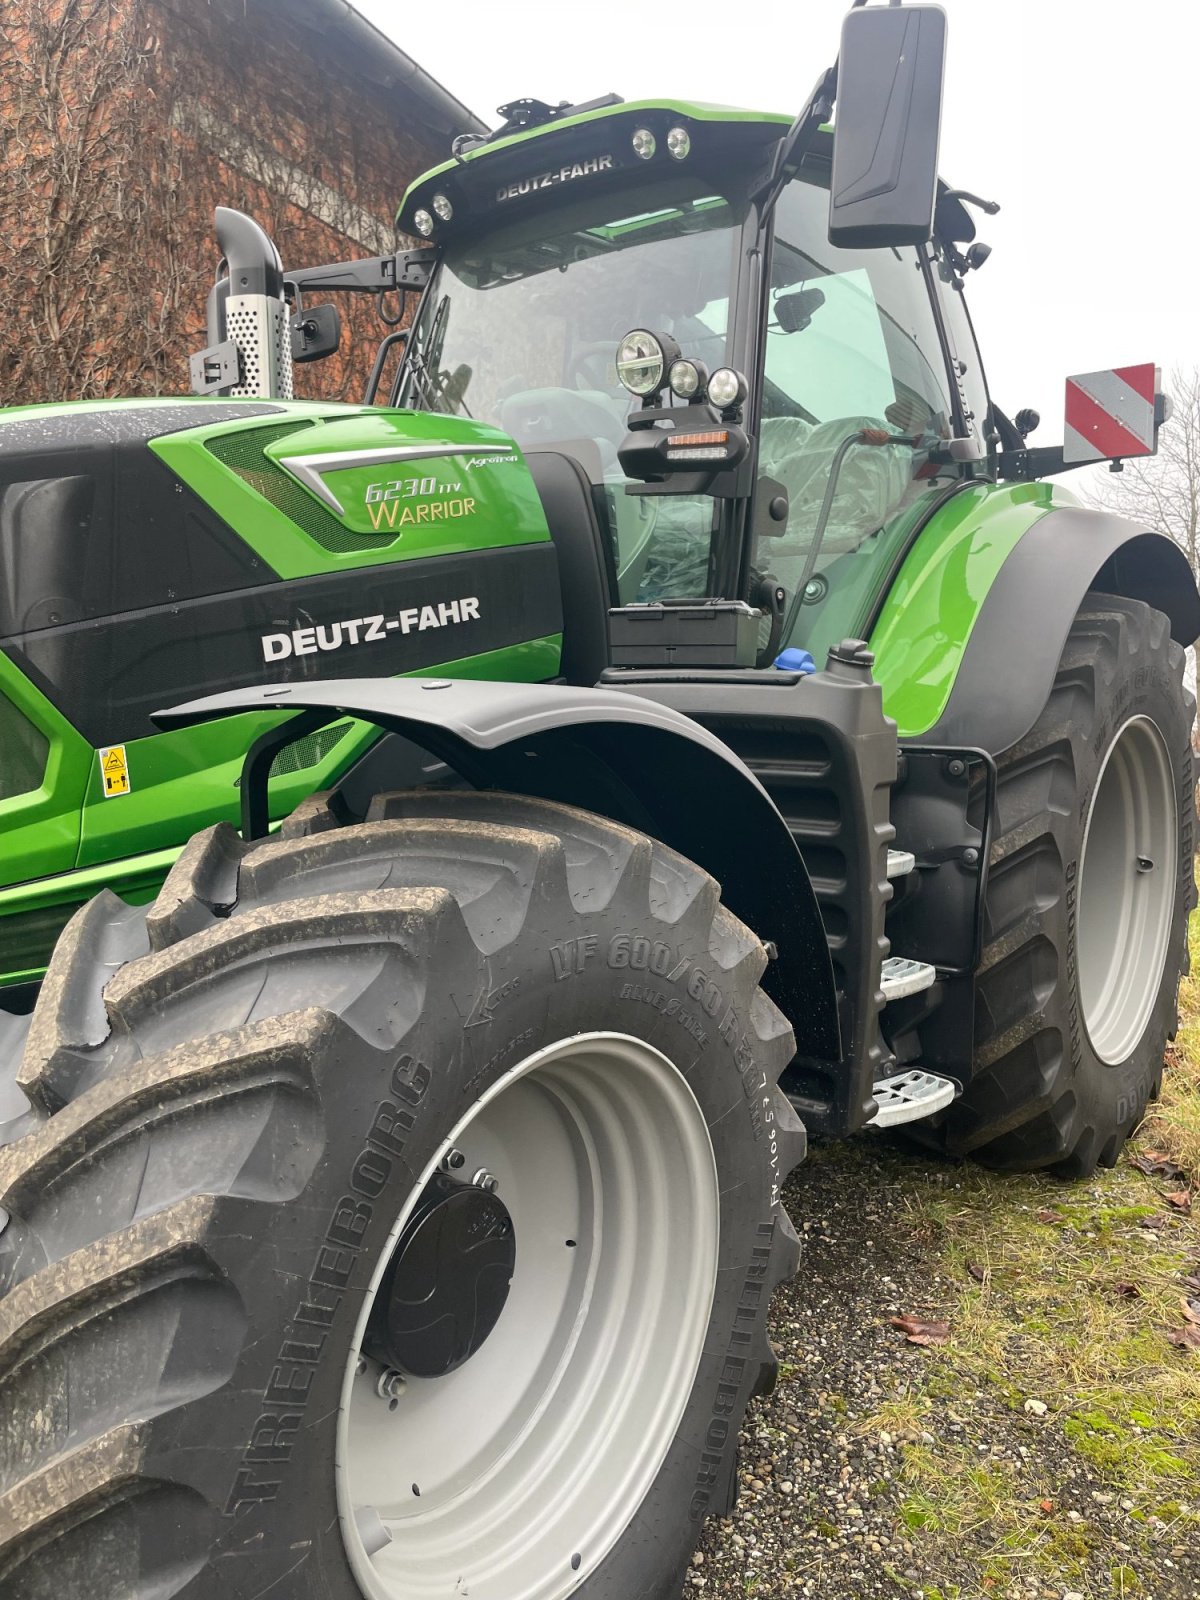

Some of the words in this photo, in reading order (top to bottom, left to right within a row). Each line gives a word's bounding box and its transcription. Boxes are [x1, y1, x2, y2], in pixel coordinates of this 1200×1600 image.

[495, 154, 614, 202] DEUTZ-FAHR
[465, 455, 518, 471] Agrotron
[365, 477, 436, 503] 6230
[439, 482, 461, 494] TTV
[367, 497, 477, 530] WARRIOR
[261, 597, 481, 662] DEUTZ-FAHR
[222, 1053, 432, 1518] TRELLEBORG
[687, 1215, 777, 1523] TRELLEBORG
